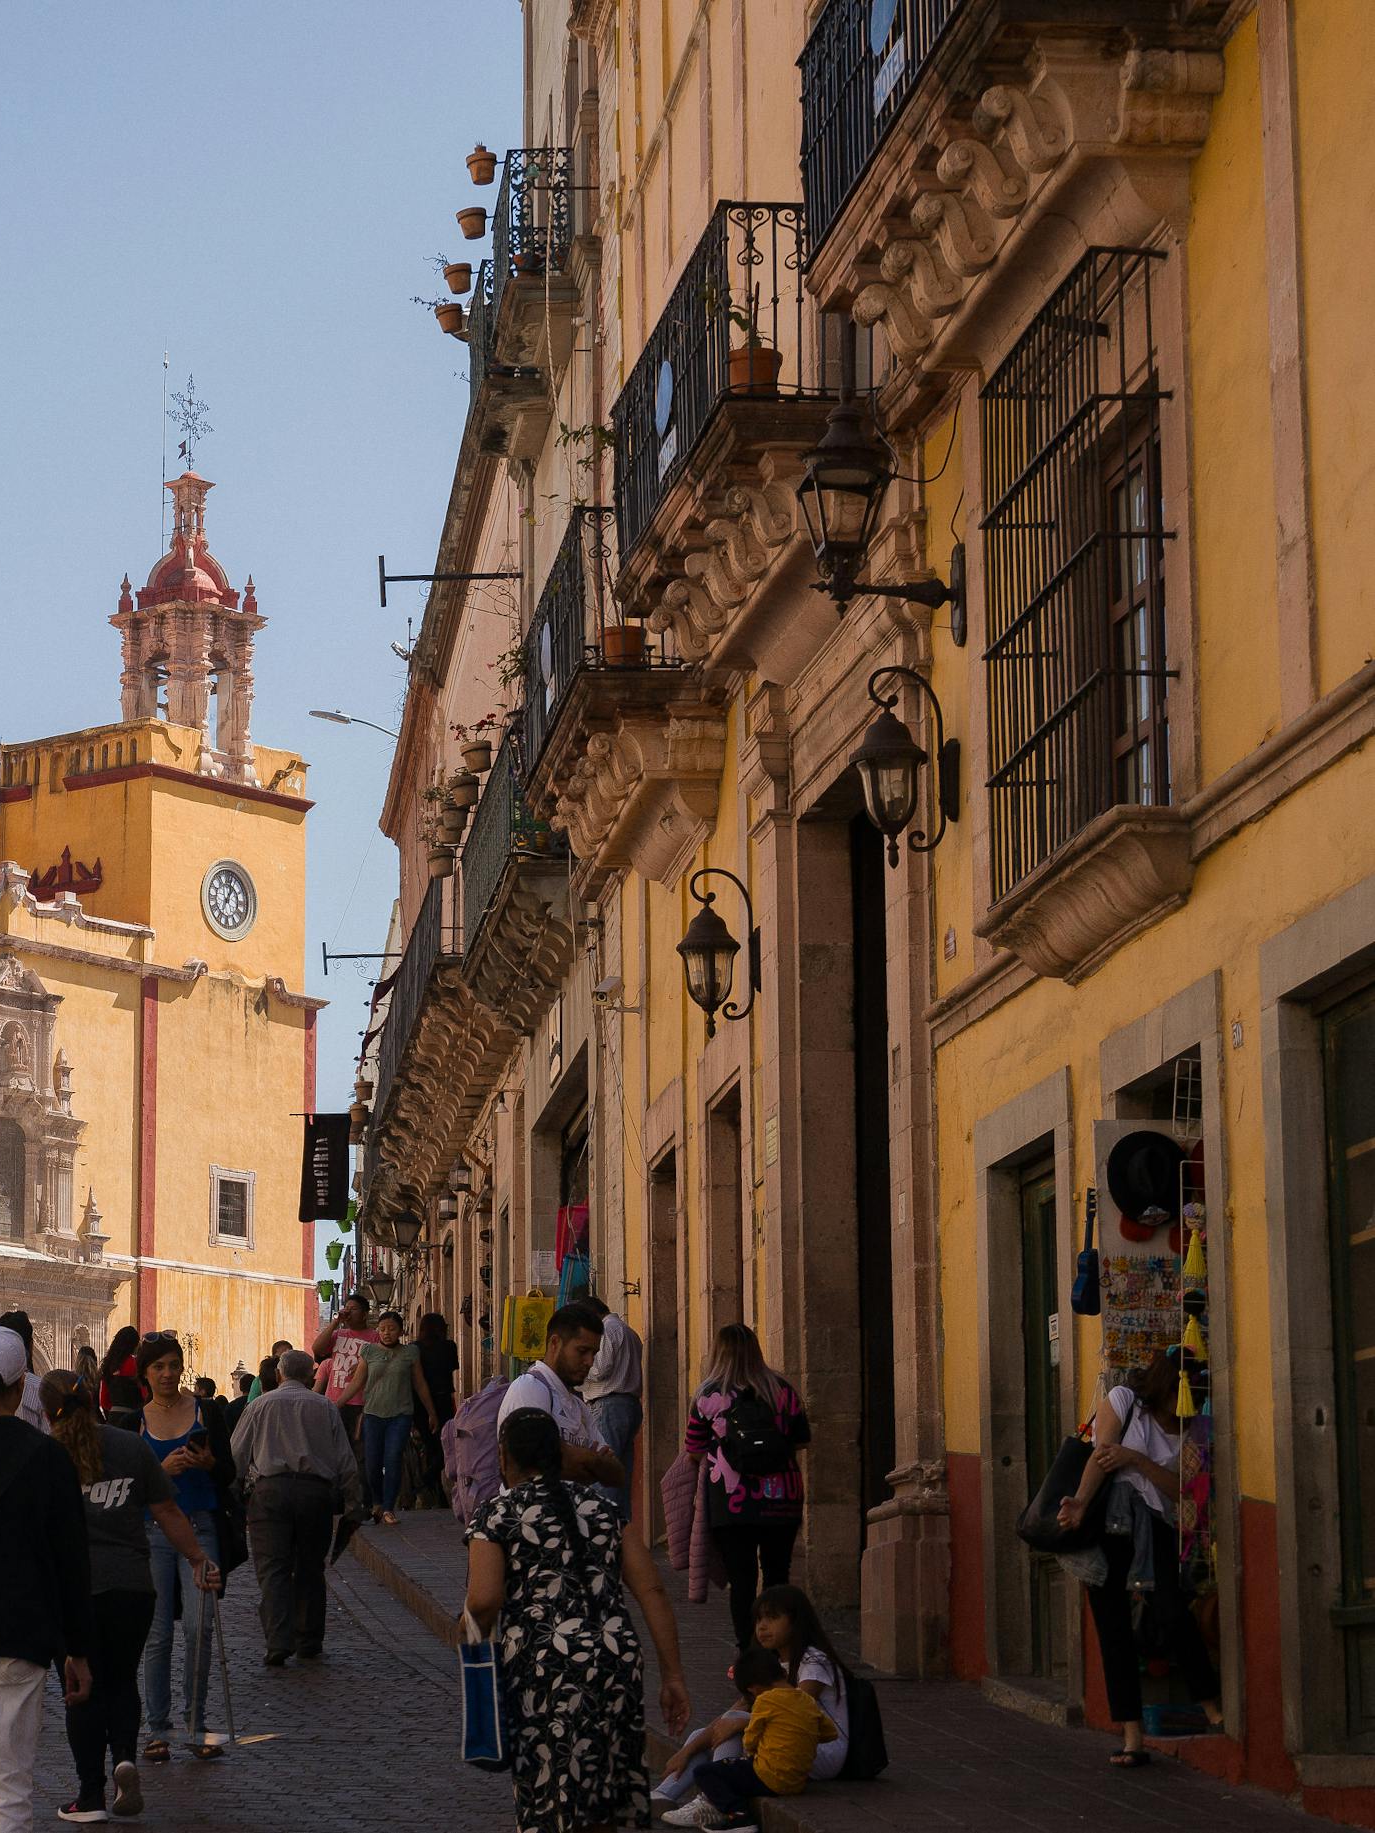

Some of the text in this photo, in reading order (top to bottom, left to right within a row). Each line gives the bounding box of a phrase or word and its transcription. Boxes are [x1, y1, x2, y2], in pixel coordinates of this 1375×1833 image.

[874, 42, 905, 112] HOTEL
[312, 1136, 329, 1207] PORFIRIA
[333, 1336, 371, 1357] JUST
[333, 1353, 359, 1371] DO
